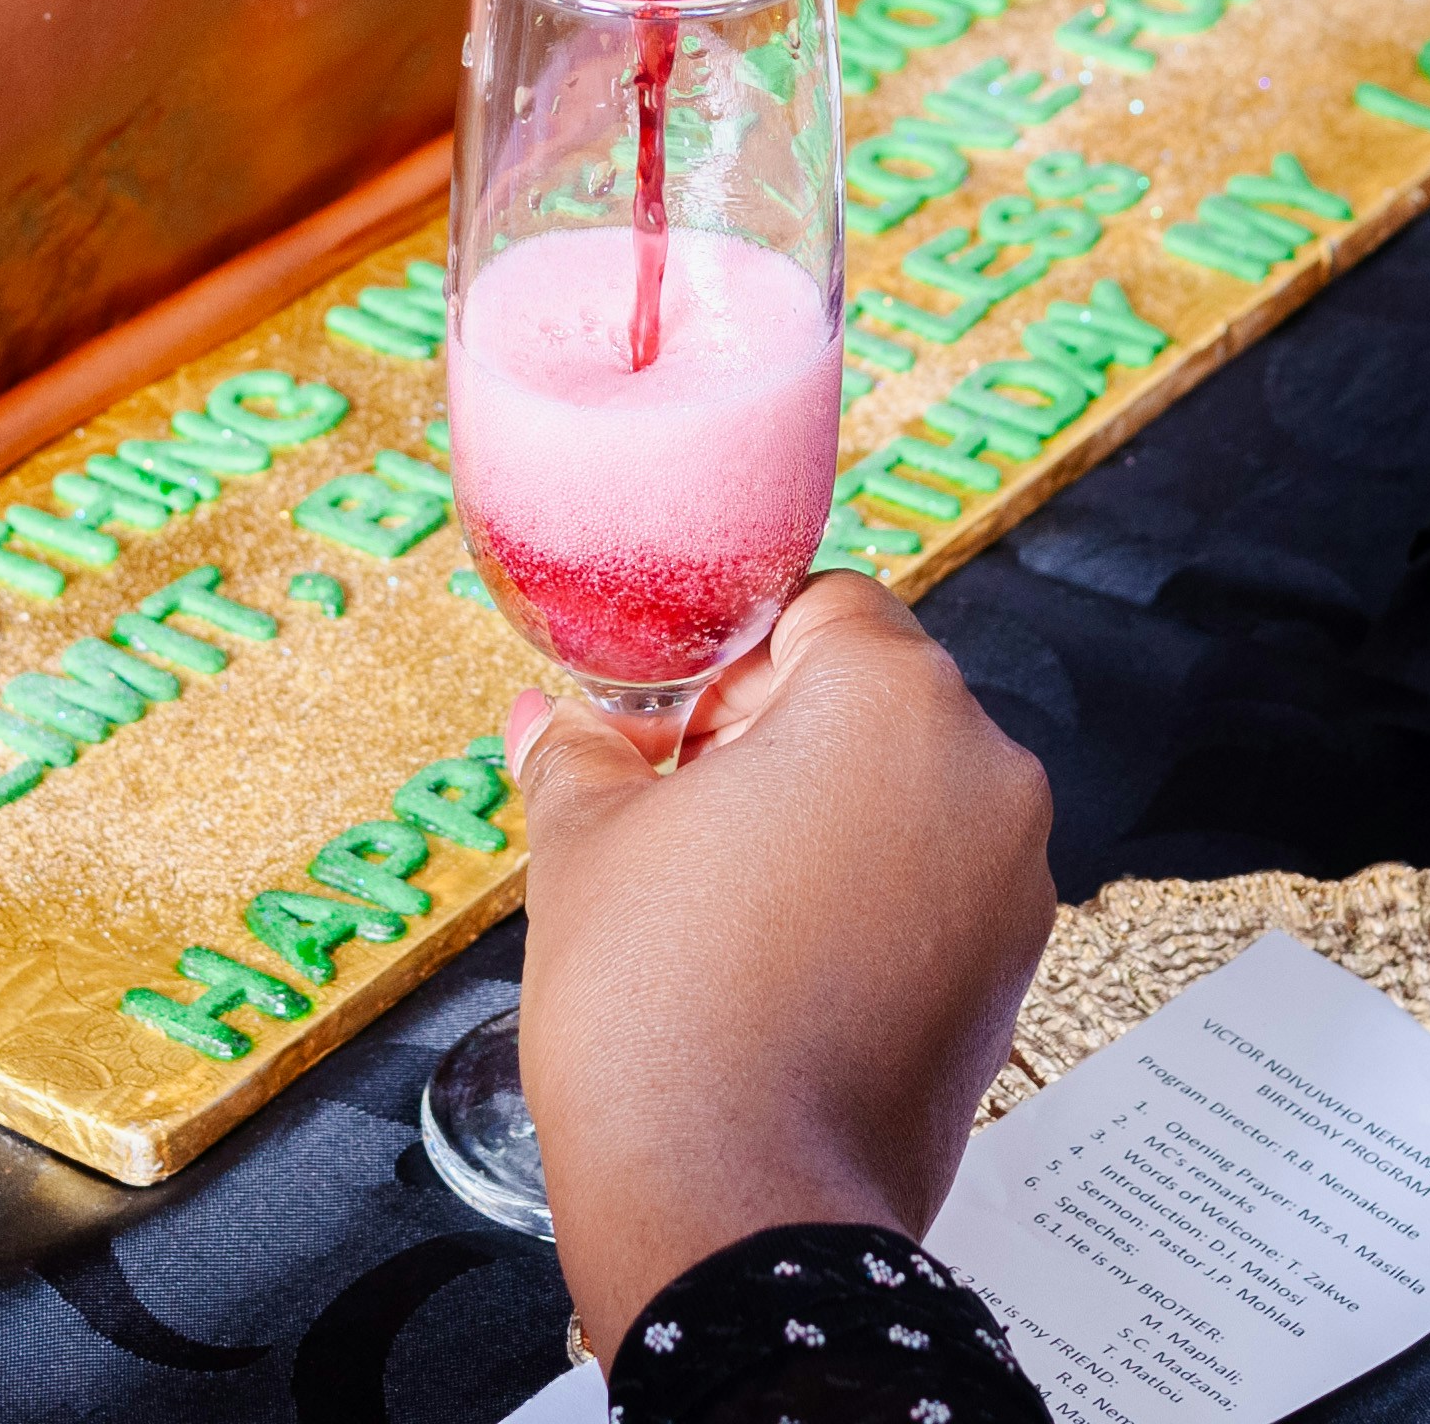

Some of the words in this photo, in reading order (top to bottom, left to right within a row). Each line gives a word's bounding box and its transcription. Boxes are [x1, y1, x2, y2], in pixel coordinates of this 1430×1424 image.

[119, 736, 509, 1061] HAPP
[1162, 152, 1354, 284] MY
[1203, 1018, 1265, 1062] VICTOR
[1263, 1058, 1363, 1124] NDIVUWHO
[1256, 1084, 1344, 1140] BIRTHDAY
[1111, 1114, 1127, 1129] 2.
[1186, 1166, 1256, 1214] remarks
[1134, 1100, 1147, 1115] 1.
[1165, 1121, 1235, 1172] Opening
[1235, 1167, 1297, 1211] Prayer:
[1297, 1208, 1333, 1234] Mrs
[1331, 1233, 1349, 1248] A.
[1354, 1244, 1426, 1295] Masilela
[1137, 1055, 1208, 1104] Program
[1208, 1102, 1282, 1152] Director:
[1282, 1149, 1314, 1175] R.B.
[1317, 1172, 1420, 1240] Nemakonde
[1023, 1176, 1040, 1191] 6.
[1054, 1195, 1139, 1256] Speeches:
[1045, 1159, 1063, 1175] 5.
[1076, 1180, 1149, 1231] Sermon:
[1148, 1228, 1206, 1268] Pastor
[1202, 1267, 1232, 1291] J.P.
[1235, 1287, 1305, 1337] Mohlala
[1069, 1145, 1084, 1159] 4.
[1099, 1164, 1208, 1242] Introduction:
[1208, 1239, 1237, 1263] D.I.
[1240, 1260, 1307, 1306] Mahosi
[1089, 1129, 1106, 1144] 3.
[1123, 1148, 1178, 1190] Words
[1178, 1190, 1204, 1204] of
[1200, 1201, 1284, 1262] Welcome:
[1286, 1258, 1302, 1275] T.
[1302, 1271, 1360, 1312] Zakwe
[976, 1286, 1002, 1307] He
[1002, 1304, 1020, 1318] is
[1019, 1318, 1050, 1339] my
[1048, 1337, 1119, 1388] FRIEND:
[1064, 1233, 1090, 1254] He
[1090, 1251, 1108, 1266] is
[1107, 1265, 1138, 1285] my
[1137, 1282, 1224, 1343] BROTHER:
[1056, 1371, 1087, 1399] R.B.
[1102, 1343, 1118, 1359] T.
[1116, 1327, 1150, 1353] S.C.
[1152, 1351, 1237, 1411] Madzana;
[1139, 1313, 1163, 1334] M.
[1166, 1331, 1243, 1386] Maphali;
[1056, 1402, 1090, 1424] Ma
